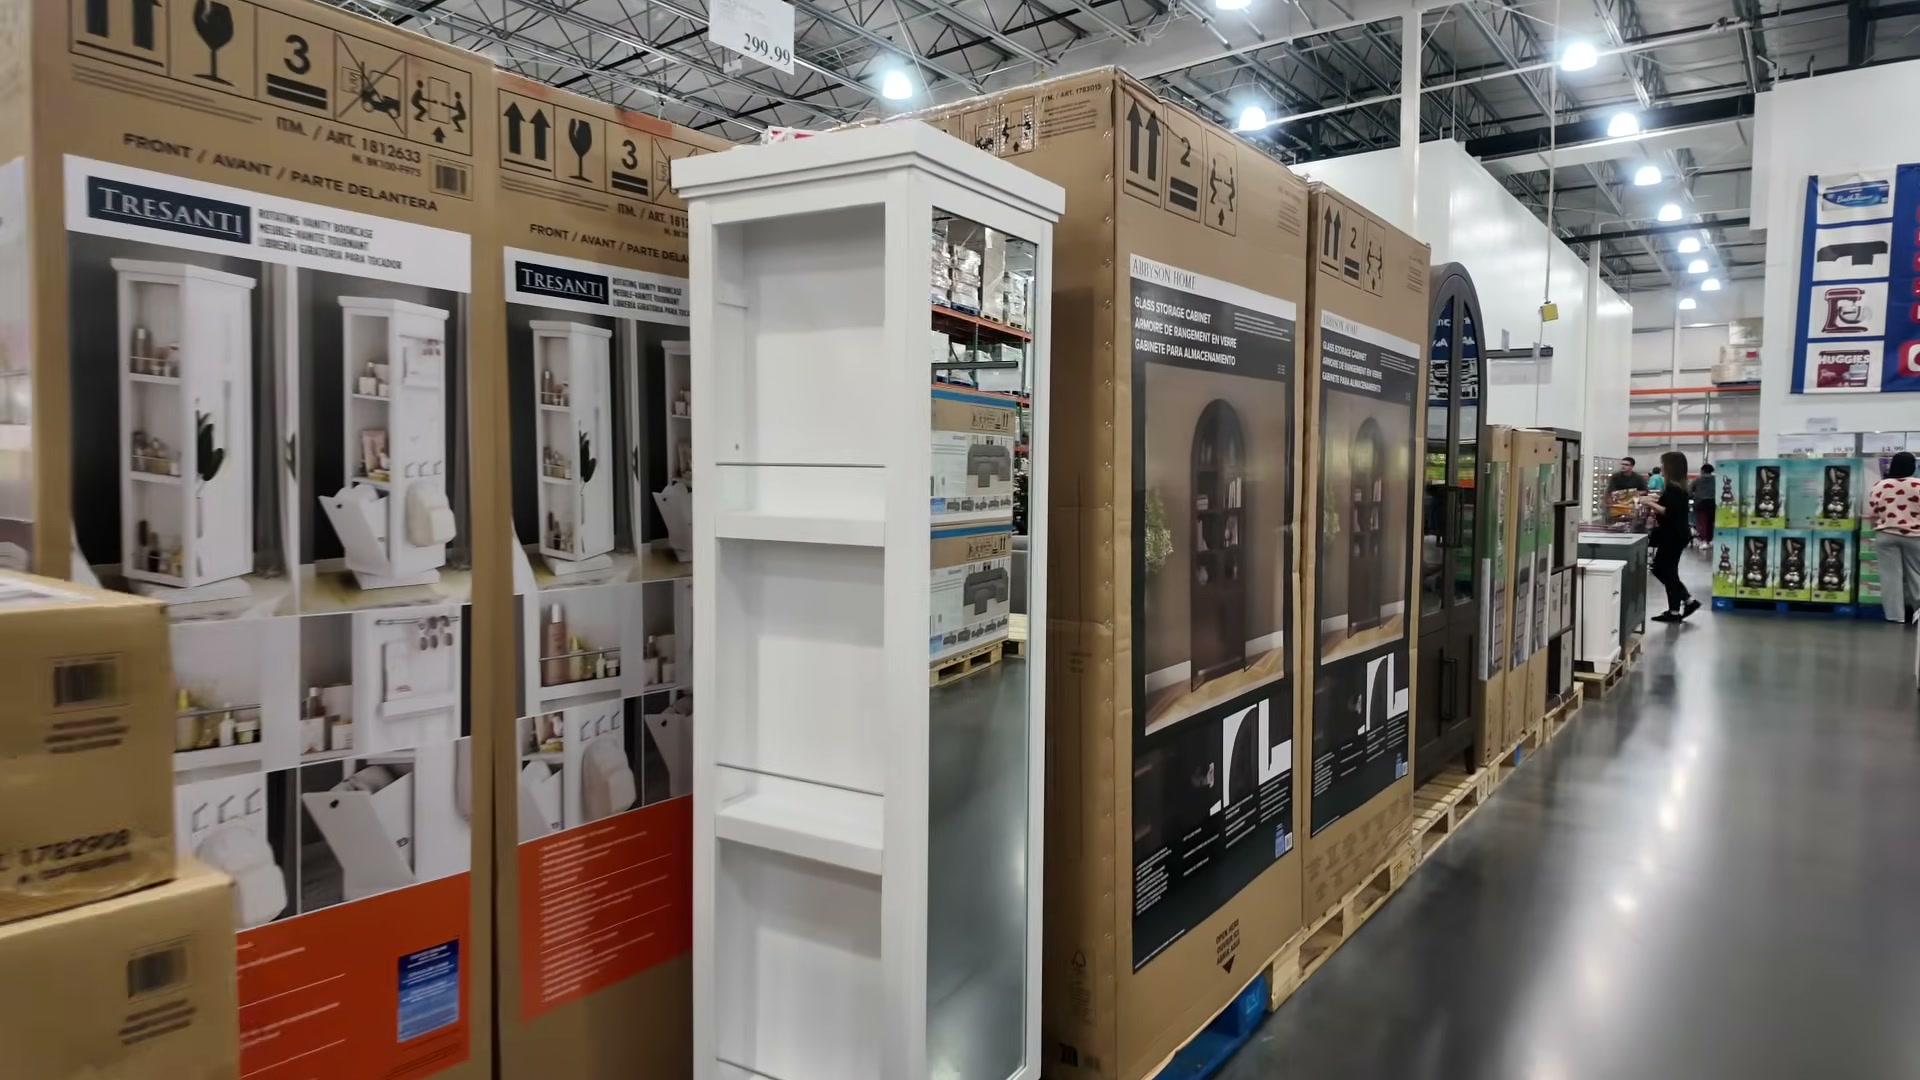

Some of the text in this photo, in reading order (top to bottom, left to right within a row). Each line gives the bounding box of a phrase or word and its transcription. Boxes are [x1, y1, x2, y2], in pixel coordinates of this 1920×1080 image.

[283, 34, 311, 75] 3
[743, 32, 791, 66] 299.99
[1060, 88, 1074, 98] ART.
[326, 130, 357, 148] ART.
[361, 138, 421, 164] 1812633
[621, 139, 639, 170] 3
[1179, 137, 1191, 167] 2
[123, 133, 438, 212] FRONT / AVANT / PARTE DELANTERA
[97, 186, 244, 236] TRESANTI
[648, 210, 666, 224] ART.
[529, 224, 570, 240] FRONT
[571, 231, 578, 242] /
[580, 234, 617, 250] AVANT
[618, 241, 625, 251] /
[627, 243, 660, 258] PARTE
[1350, 227, 1357, 249] 2
[520, 267, 604, 299] TRESANTI
[1132, 258, 1197, 290] ABBYSON HOME
[1134, 296, 1212, 325] GLASS STORAGE CABINET
[1134, 317, 1237, 349] ARMOIRE DE RANGEMENT EN VERRE
[1134, 338, 1236, 366] GABINETE PARA ALMACENAMIENTO
[1817, 354, 1870, 365] HUGGIES
[1216, 928, 1228, 945] OPEN
